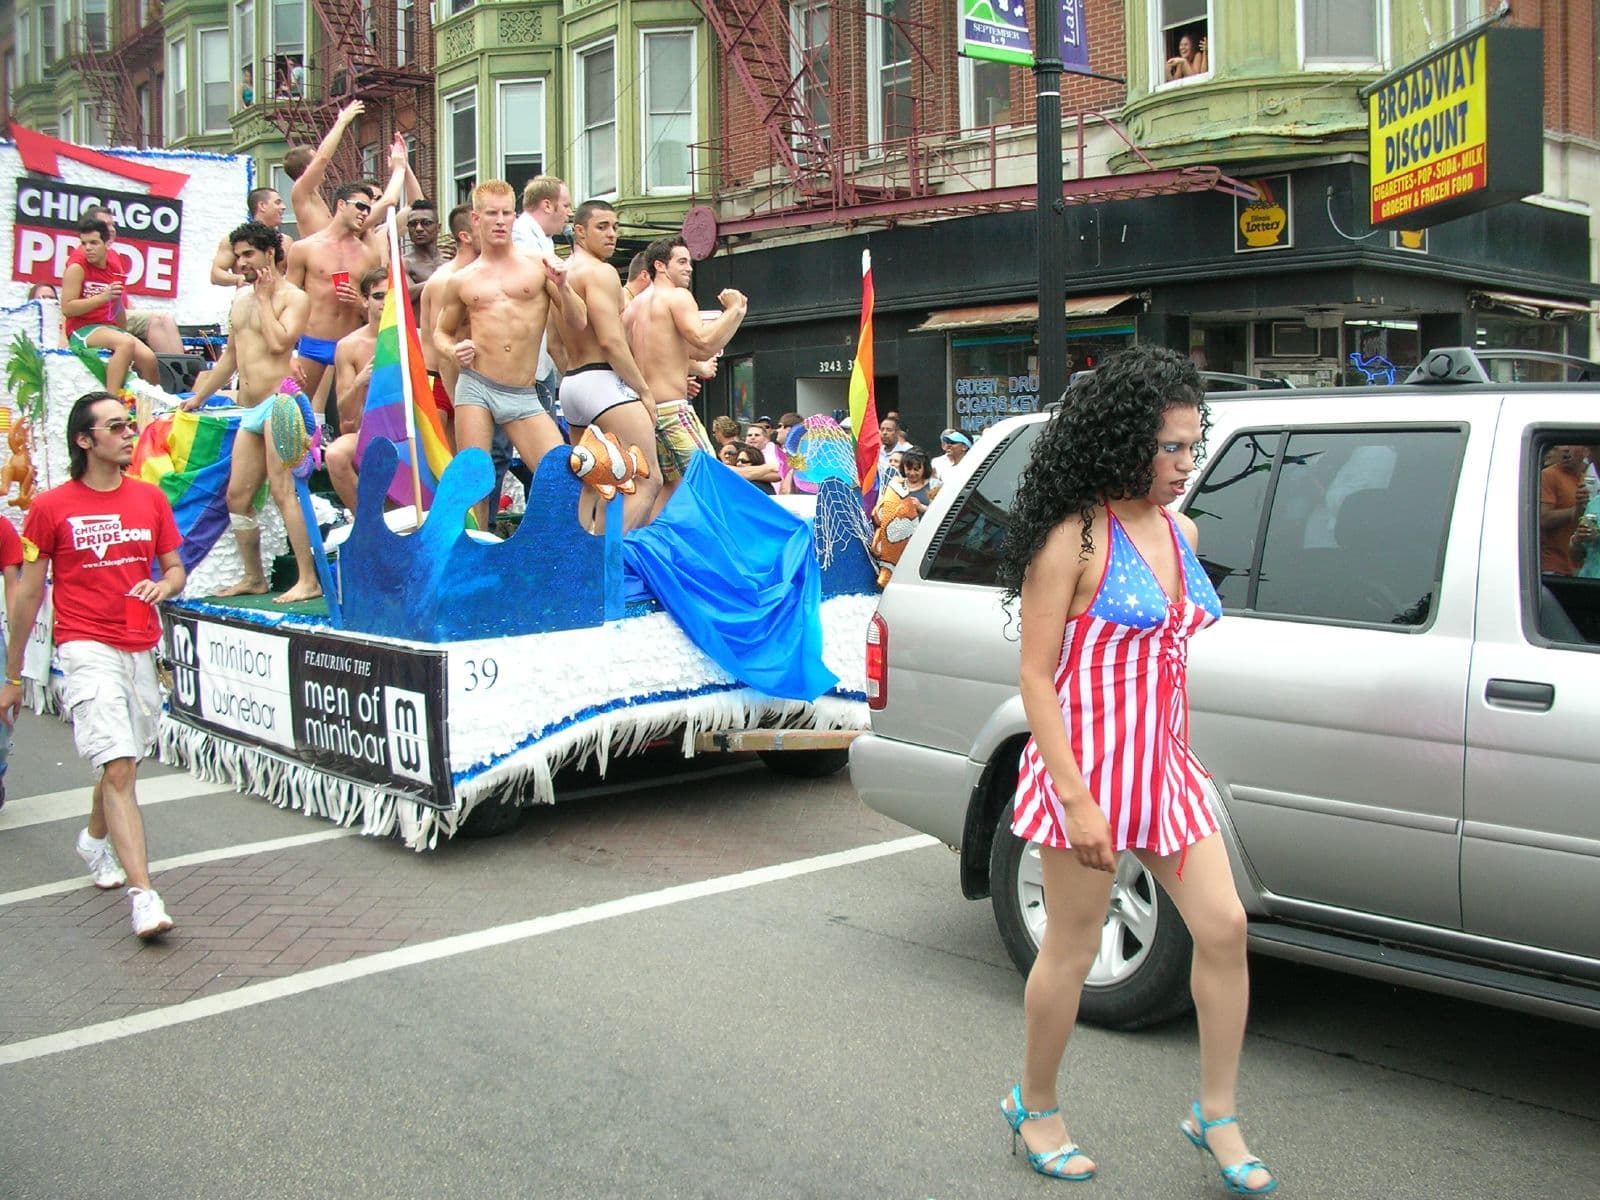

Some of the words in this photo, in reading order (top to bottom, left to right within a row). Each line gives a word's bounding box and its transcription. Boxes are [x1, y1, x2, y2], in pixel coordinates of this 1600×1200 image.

[973, 22, 1020, 40] SEPTEMBER
[1378, 40, 1478, 129] BROADWAY
[1385, 100, 1468, 174] DISCOUNT
[1374, 173, 1414, 202] CIGARETTES
[1417, 166, 1433, 186] POP
[1436, 157, 1458, 179] SODA
[1461, 145, 1484, 170] MILK
[1382, 193, 1412, 219] GROCERY
[1413, 191, 1420, 208] &
[1421, 180, 1450, 205] FROZEN
[1451, 172, 1474, 195] FOOD
[19, 229, 174, 291] PRDE
[956, 378, 999, 395] GROCERY
[1008, 376, 1040, 393] DRU
[956, 396, 1007, 413] CIGARS
[961, 415, 1010, 432] IMPO
[75, 523, 120, 536] CHICAGO
[76, 531, 121, 548] PRIDE
[210, 635, 273, 679] minibar
[304, 650, 352, 672] FEATURING
[353, 659, 372, 676] THE
[464, 657, 499, 692] 39
[213, 686, 276, 731] winebar
[305, 680, 350, 717] men
[358, 686, 380, 724] of
[305, 715, 386, 765] minibar
